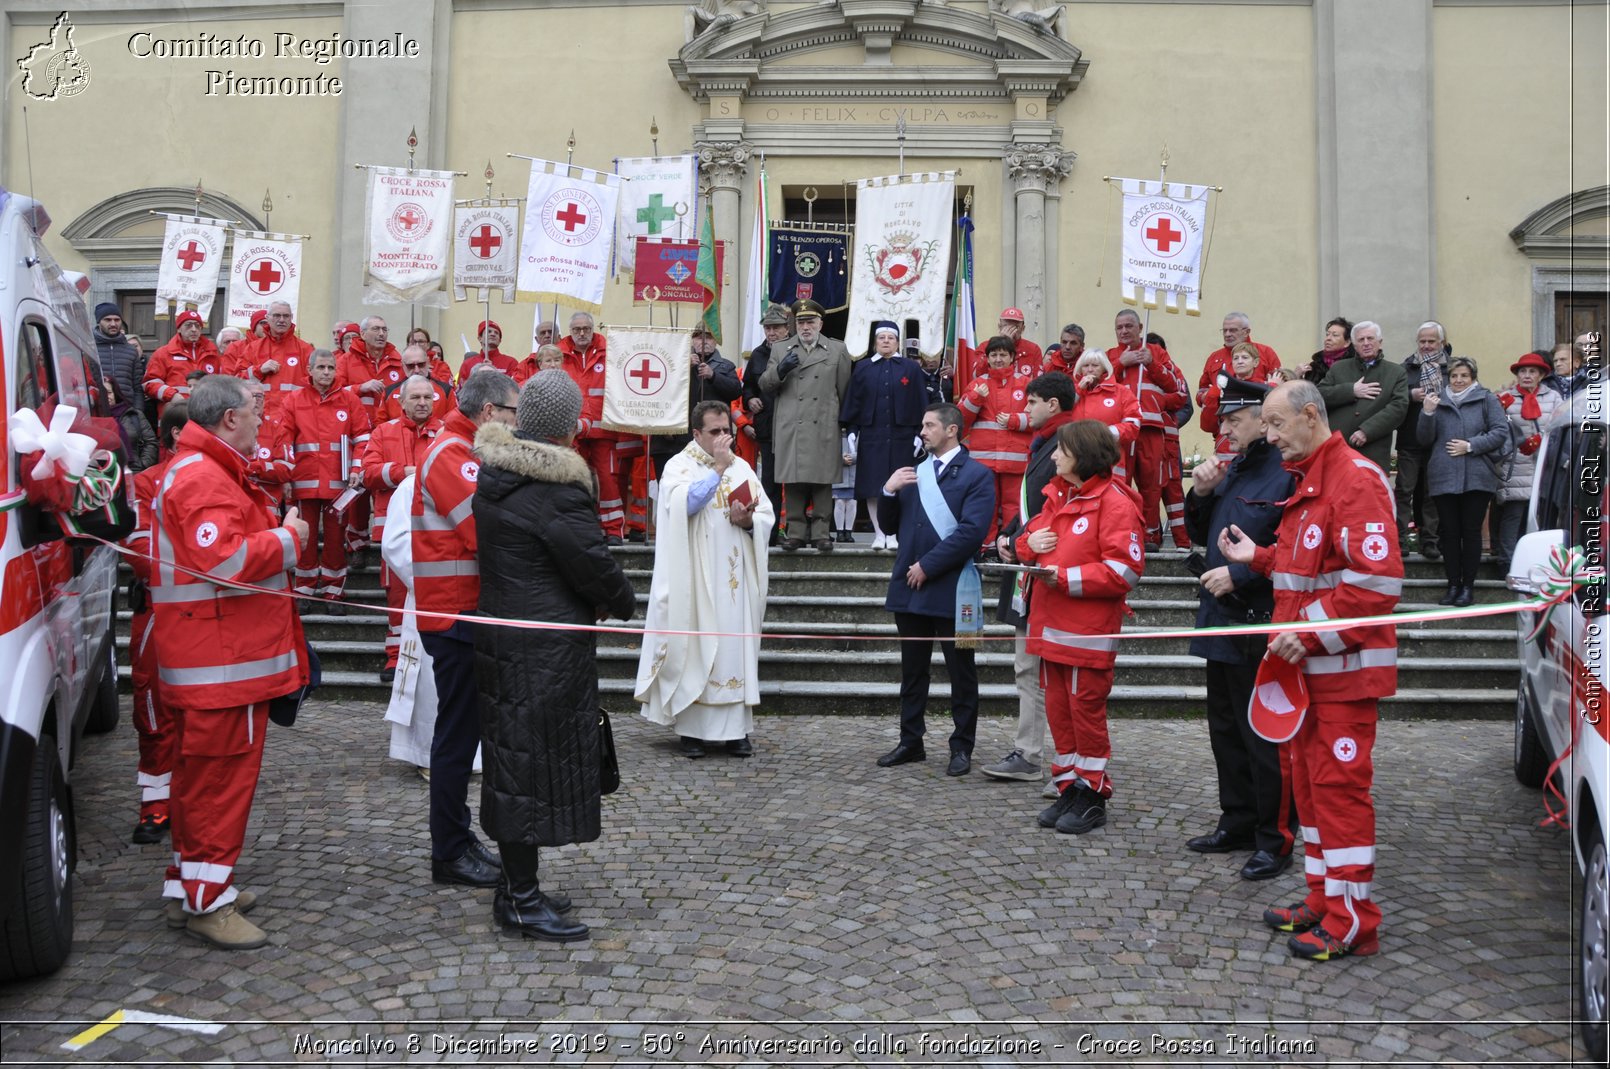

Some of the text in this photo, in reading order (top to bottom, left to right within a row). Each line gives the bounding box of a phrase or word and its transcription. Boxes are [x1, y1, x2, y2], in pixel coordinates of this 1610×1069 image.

[720, 102, 730, 115] S
[767, 109, 779, 120] O
[803, 108, 857, 121] FELIX
[1026, 102, 1038, 116] Q
[381, 176, 446, 190] CROCE ROSSA
[390, 188, 434, 198] ITALIANA
[459, 210, 513, 237] CROCE ROSSA ITALIANA
[1130, 202, 1199, 233] CROCE ROSSA ITALIANA
[235, 246, 296, 278] CROCE ROSSA ITALIANA
[378, 252, 433, 261] MONTIGLIO
[528, 256, 598, 270] Croce Rossa Italiana
[372, 261, 438, 270] MONFERRATO
[540, 266, 574, 275] COMITATO
[1129, 259, 1193, 274] COMITATO LOCALE
[1128, 277, 1172, 290] COCCONATO
[618, 400, 660, 408] DELEGAZIONE
[624, 409, 665, 418] MONCALVO
